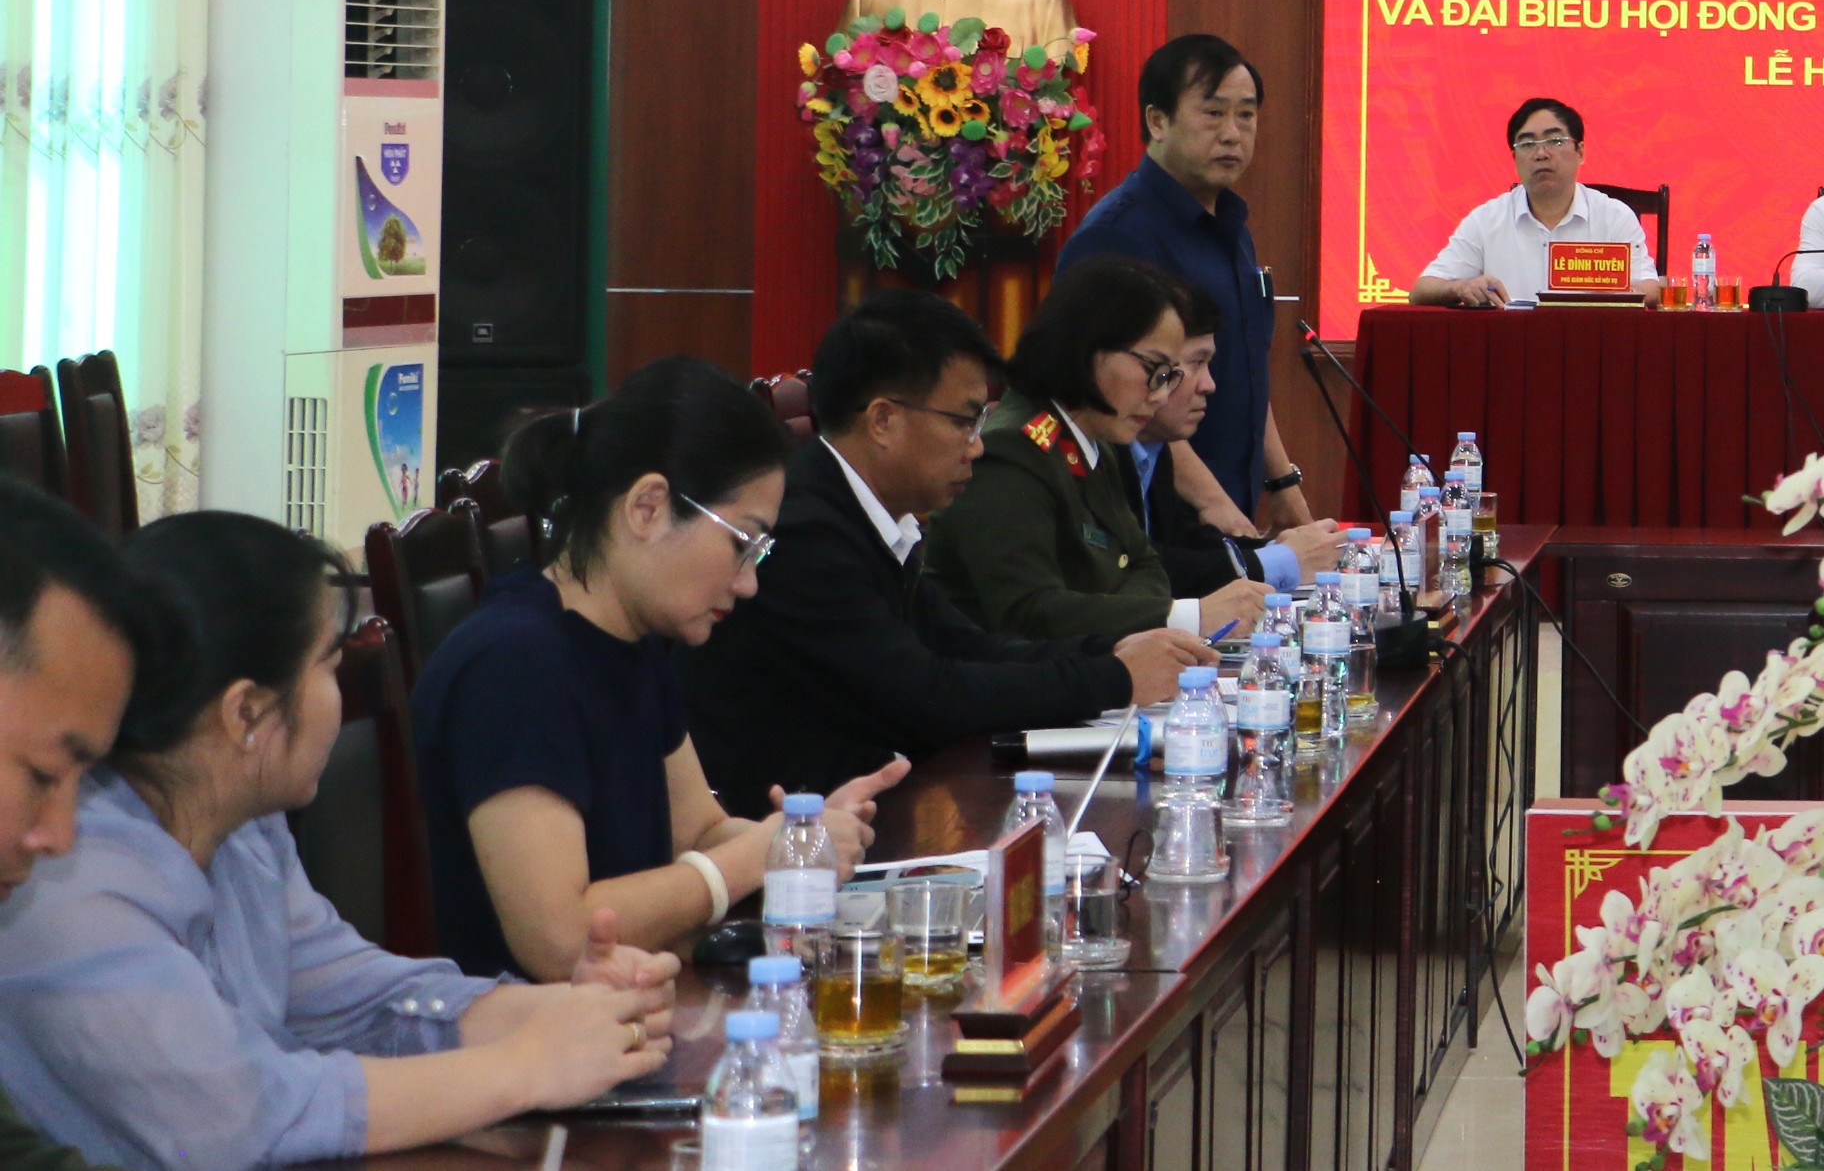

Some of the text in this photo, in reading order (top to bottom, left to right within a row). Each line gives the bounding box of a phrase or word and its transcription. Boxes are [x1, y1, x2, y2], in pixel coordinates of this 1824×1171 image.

[1744, 48, 1794, 86] LỄ
[1554, 256, 1625, 271] LÊ ĐÌNH TUYÊN
